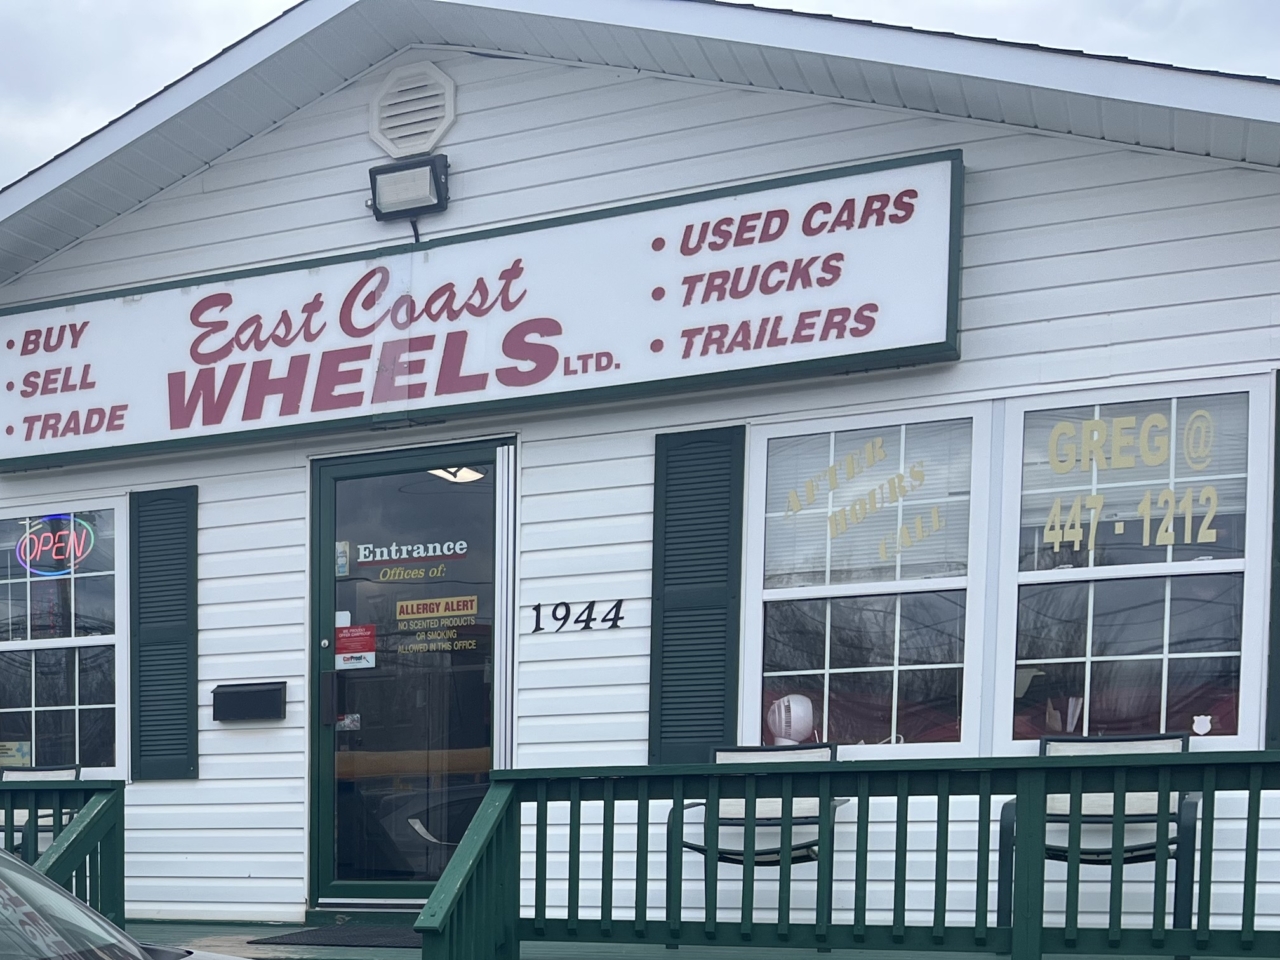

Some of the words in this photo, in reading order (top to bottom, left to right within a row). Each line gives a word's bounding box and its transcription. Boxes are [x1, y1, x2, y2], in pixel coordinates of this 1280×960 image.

[680, 209, 790, 256] USED
[801, 189, 918, 236] CARS
[681, 252, 845, 307] TRUCKS
[189, 292, 326, 365] East
[339, 258, 529, 338] Coast
[20, 321, 89, 356] BUY
[680, 303, 879, 360] TRAILERS
[20, 364, 97, 398] SELL
[167, 317, 563, 431] WHEELS
[563, 350, 621, 376] LTD.
[21, 404, 128, 442] TRADE
[1048, 413, 1169, 474] GREG
[1183, 409, 1214, 471] @
[783, 436, 887, 519] AFTER
[828, 460, 926, 539] HOURS
[20, 529, 87, 562] OPEN
[357, 540, 468, 562] Entrance
[878, 506, 947, 561] CALL
[379, 567, 425, 581] Offices
[429, 564, 447, 578] of:
[398, 602, 441, 616] ALLERGY
[444, 599, 476, 613] ALERT
[398, 621, 408, 630] NO
[409, 618, 439, 630] SCENTED
[440, 616, 475, 627] PRODUCTS
[531, 599, 625, 633] 1944
[398, 642, 428, 654] ALLOWED
[429, 642, 436, 651] IN
[438, 641, 452, 651] THIS
[454, 640, 477, 650] OFFICE
[416, 631, 426, 641] OR
[427, 629, 457, 640] SMOKING
